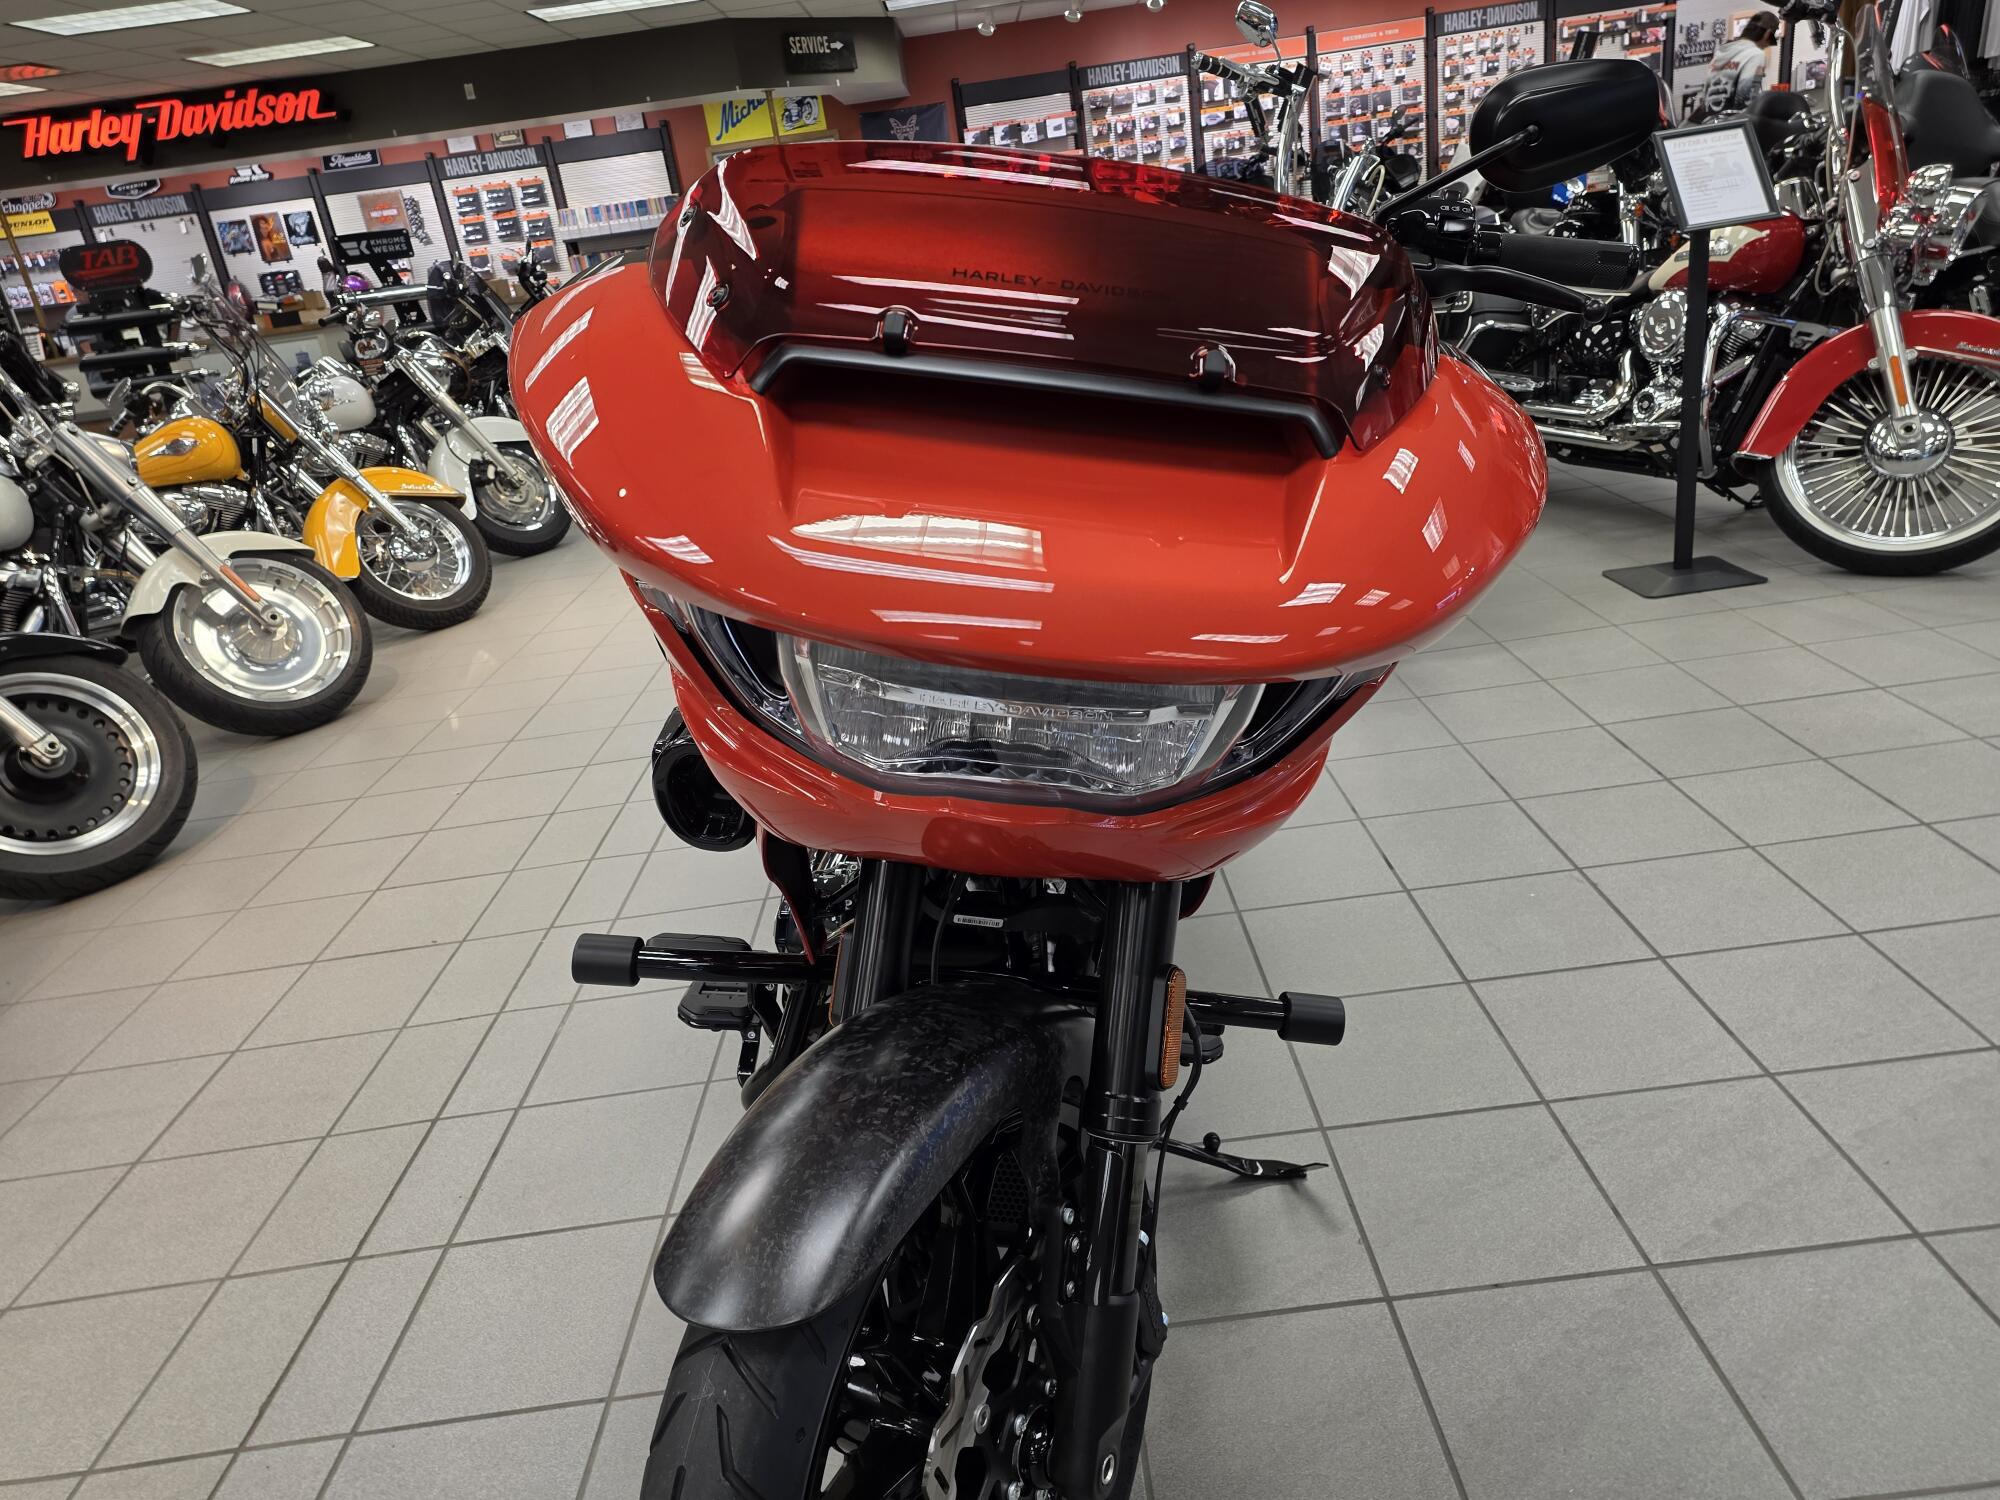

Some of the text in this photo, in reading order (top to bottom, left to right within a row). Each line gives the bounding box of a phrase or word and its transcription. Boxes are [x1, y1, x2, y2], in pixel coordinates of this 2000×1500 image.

[1444, 1, 1539, 33] HARLEY-DAVIDSON
[789, 35, 831, 54] SERVICE
[1087, 55, 1181, 86] HARLEY-DAVIDSON
[3, 88, 337, 162] Harley-Davidson
[443, 147, 539, 177] HARLEY-DAVIDSON
[93, 195, 188, 224] HARLEY-DAVIDSON
[369, 235, 406, 246] KHROME
[372, 243, 408, 254] WERKS
[80, 245, 139, 271] TAB
